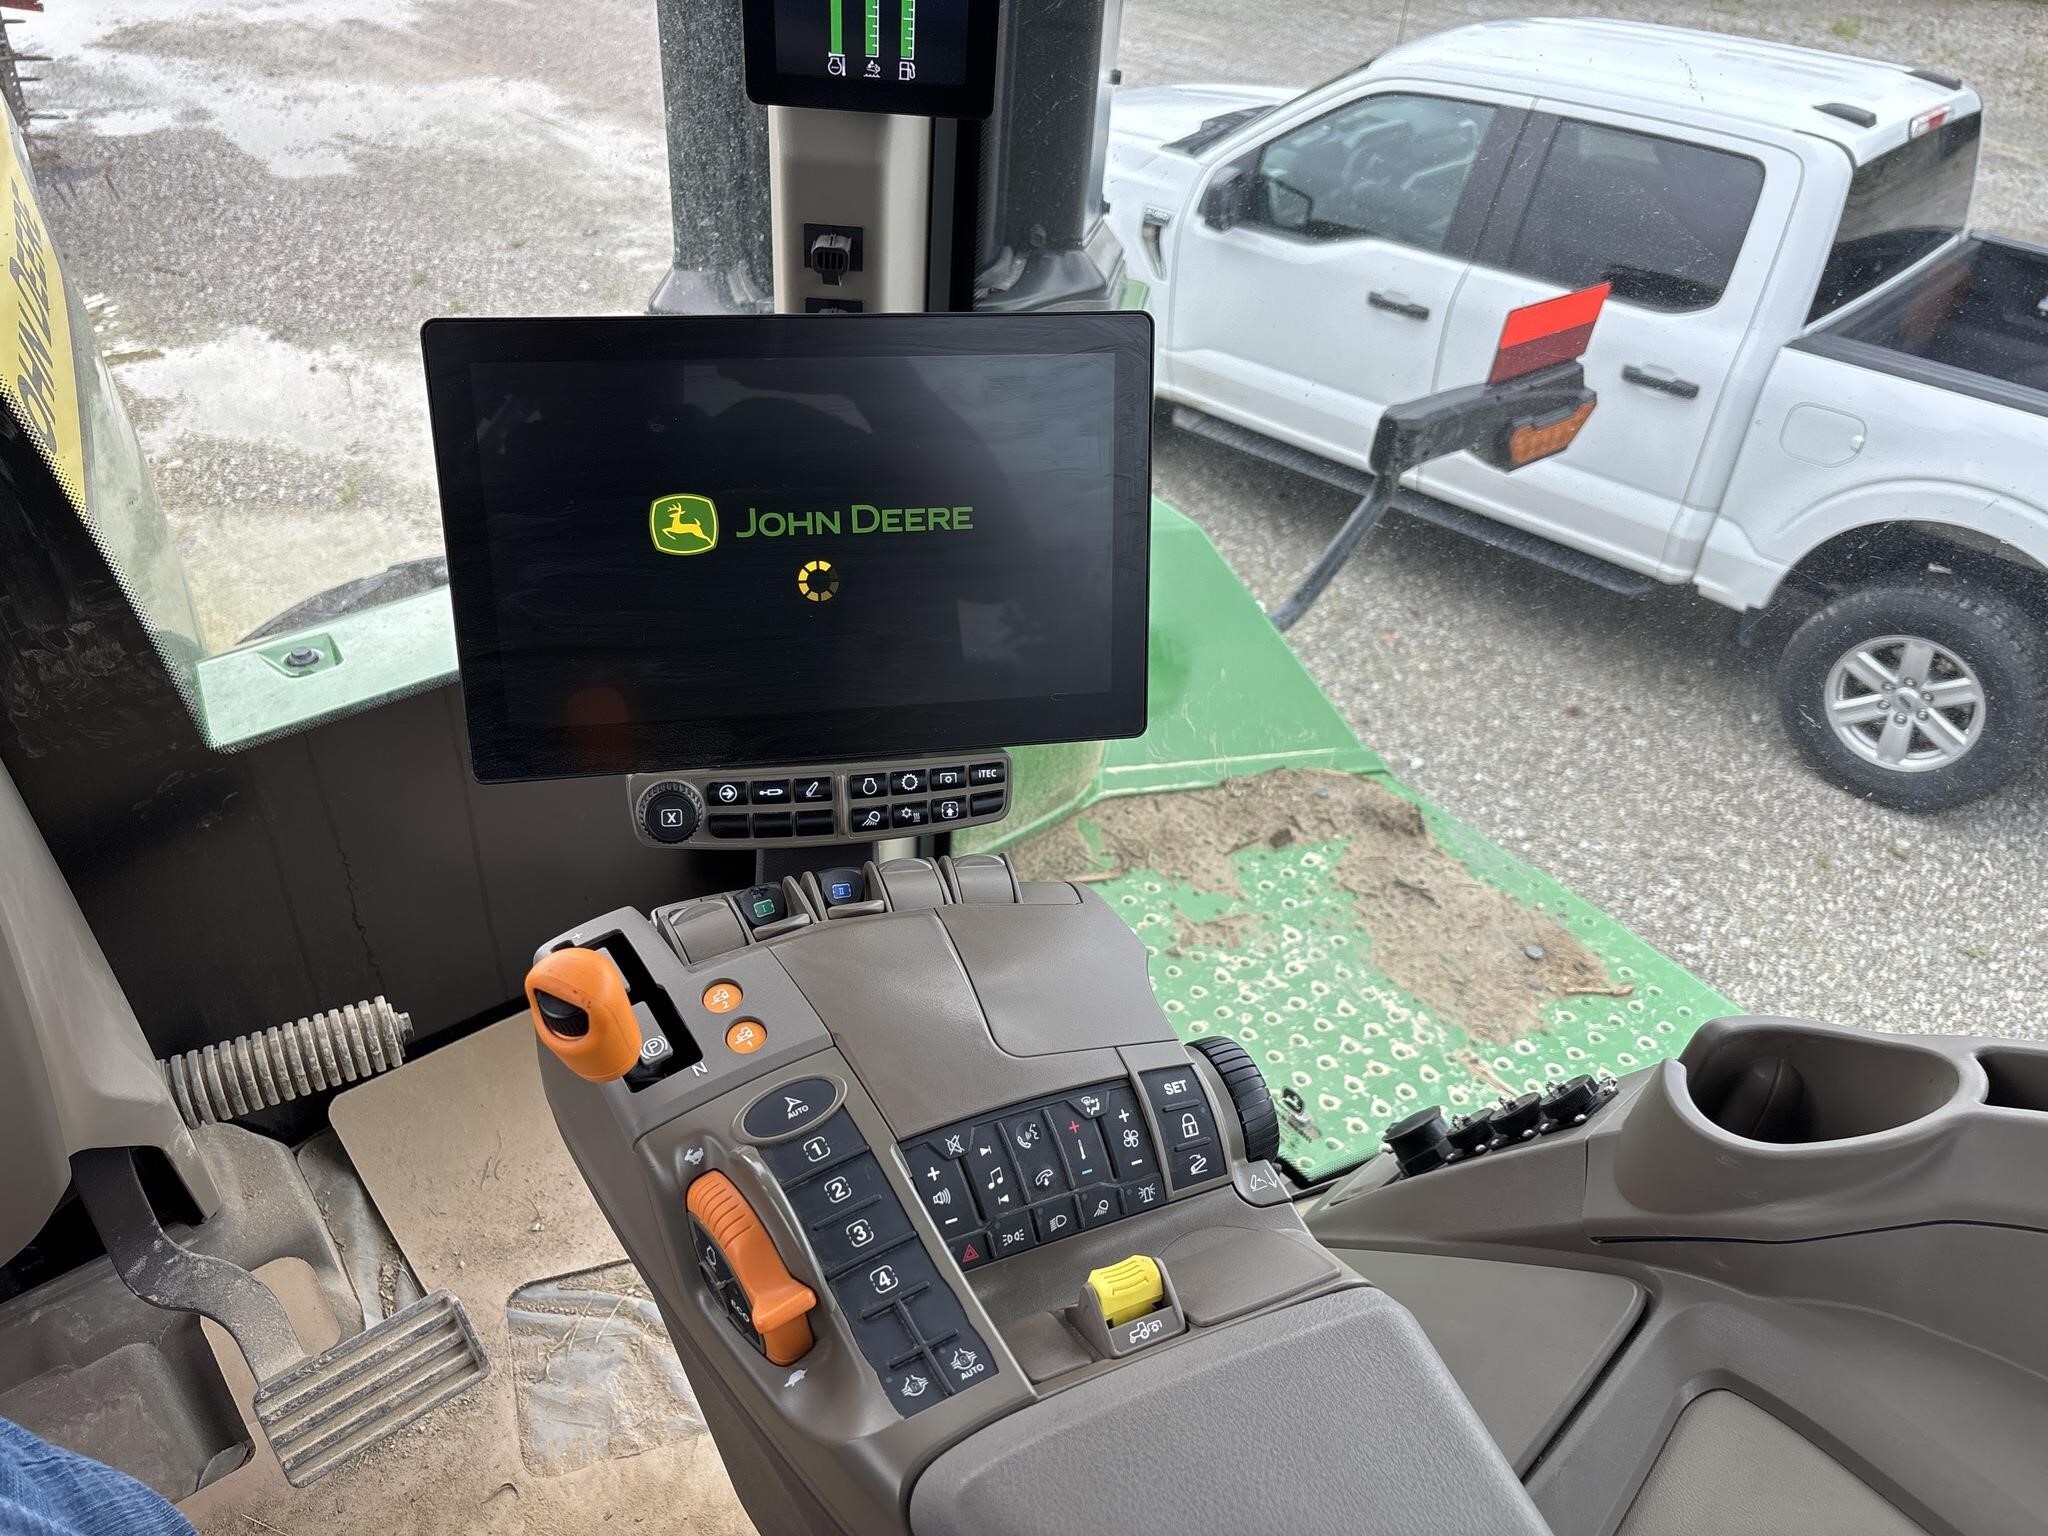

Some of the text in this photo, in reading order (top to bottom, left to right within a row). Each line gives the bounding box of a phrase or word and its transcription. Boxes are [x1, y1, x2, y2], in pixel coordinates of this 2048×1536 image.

[9, 176, 58, 456] OHN DEERE
[735, 504, 974, 539] JOHN DEERE
[978, 768, 997, 778] iTEC
[667, 812, 677, 824] X
[647, 1041, 659, 1054] P
[691, 1061, 708, 1077] N
[1163, 1079, 1188, 1096] SET
[787, 1104, 809, 1120] AUTO
[810, 1142, 823, 1156] 1
[831, 1182, 846, 1199] 2
[853, 1225, 867, 1241] 3
[878, 1271, 891, 1287] 4
[960, 1363, 985, 1381] AUTO
